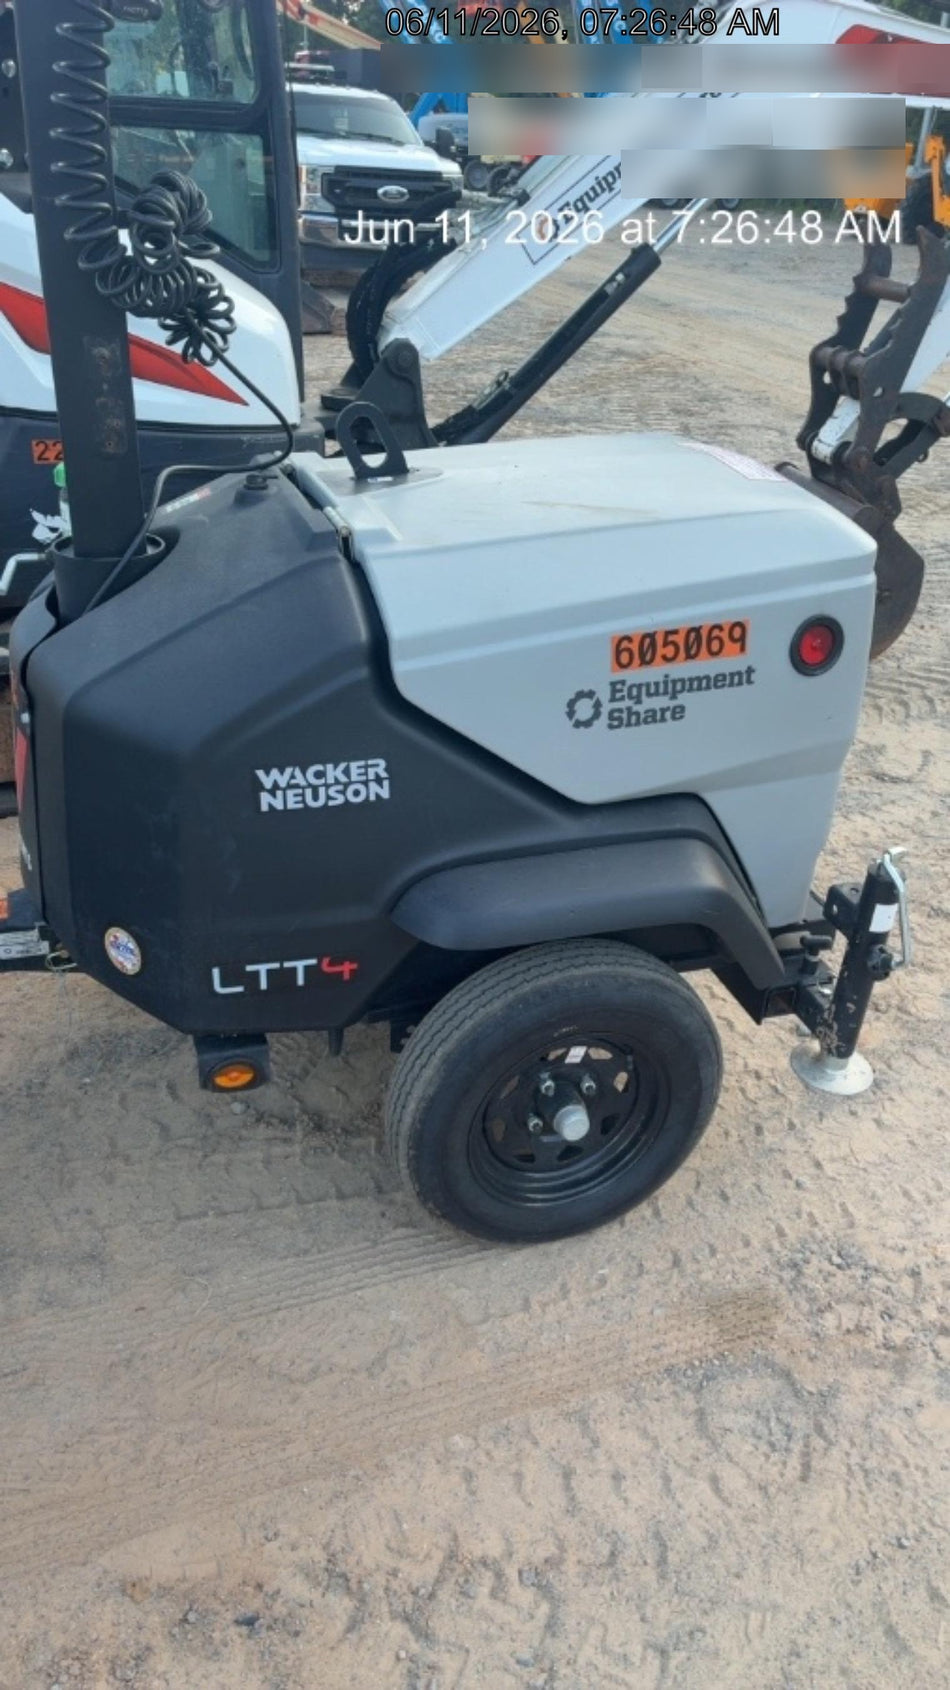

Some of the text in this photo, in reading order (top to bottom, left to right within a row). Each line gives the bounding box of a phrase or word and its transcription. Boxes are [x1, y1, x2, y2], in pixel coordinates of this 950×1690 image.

[614, 621, 748, 670] 605069
[608, 665, 756, 704] Equipment
[606, 703, 686, 730] Share
[254, 758, 389, 790] WACKER
[259, 780, 390, 812] NEUSON
[211, 955, 358, 995] LTT4
